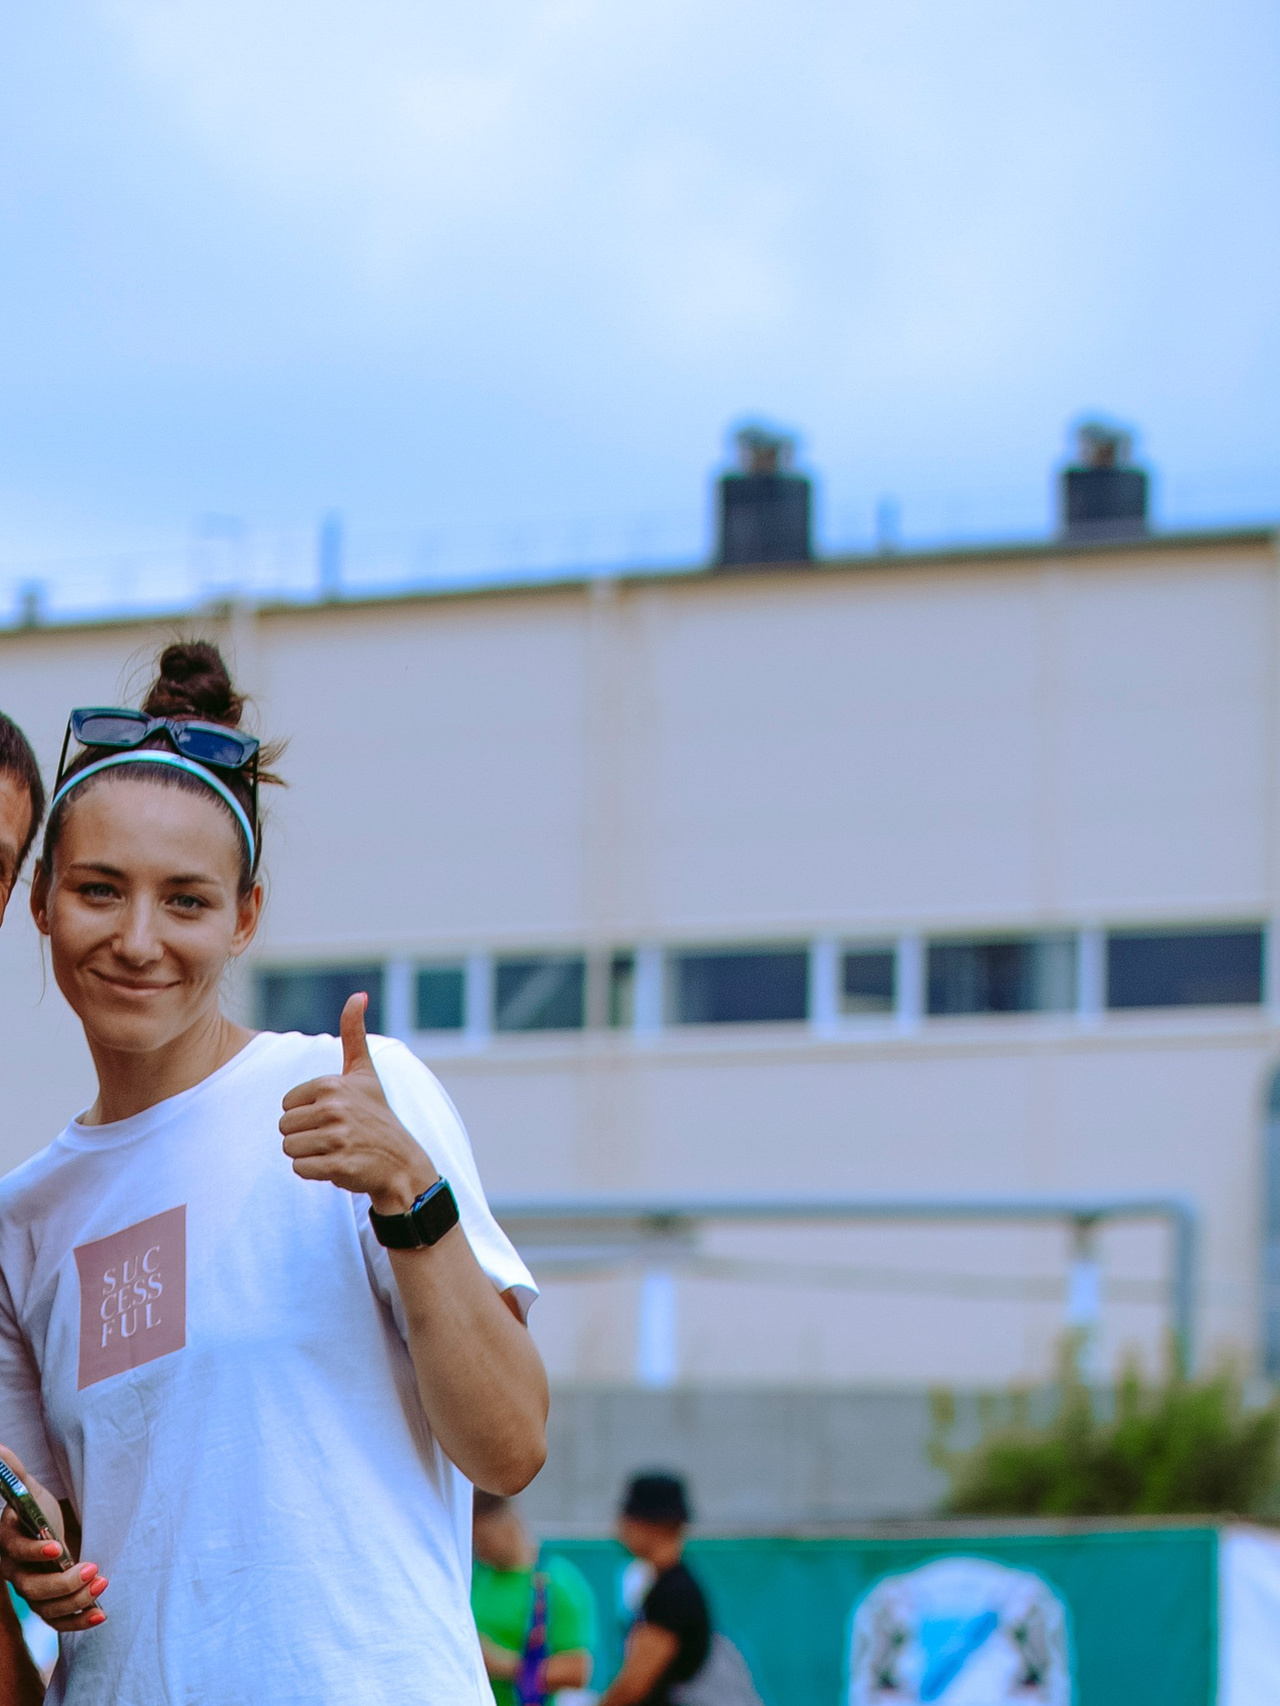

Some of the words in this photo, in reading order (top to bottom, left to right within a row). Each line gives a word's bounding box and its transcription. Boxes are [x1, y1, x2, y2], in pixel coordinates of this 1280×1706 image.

[102, 1245, 160, 1295] SUC
[100, 1272, 163, 1321] CESS
[101, 1302, 162, 1348] FUL
